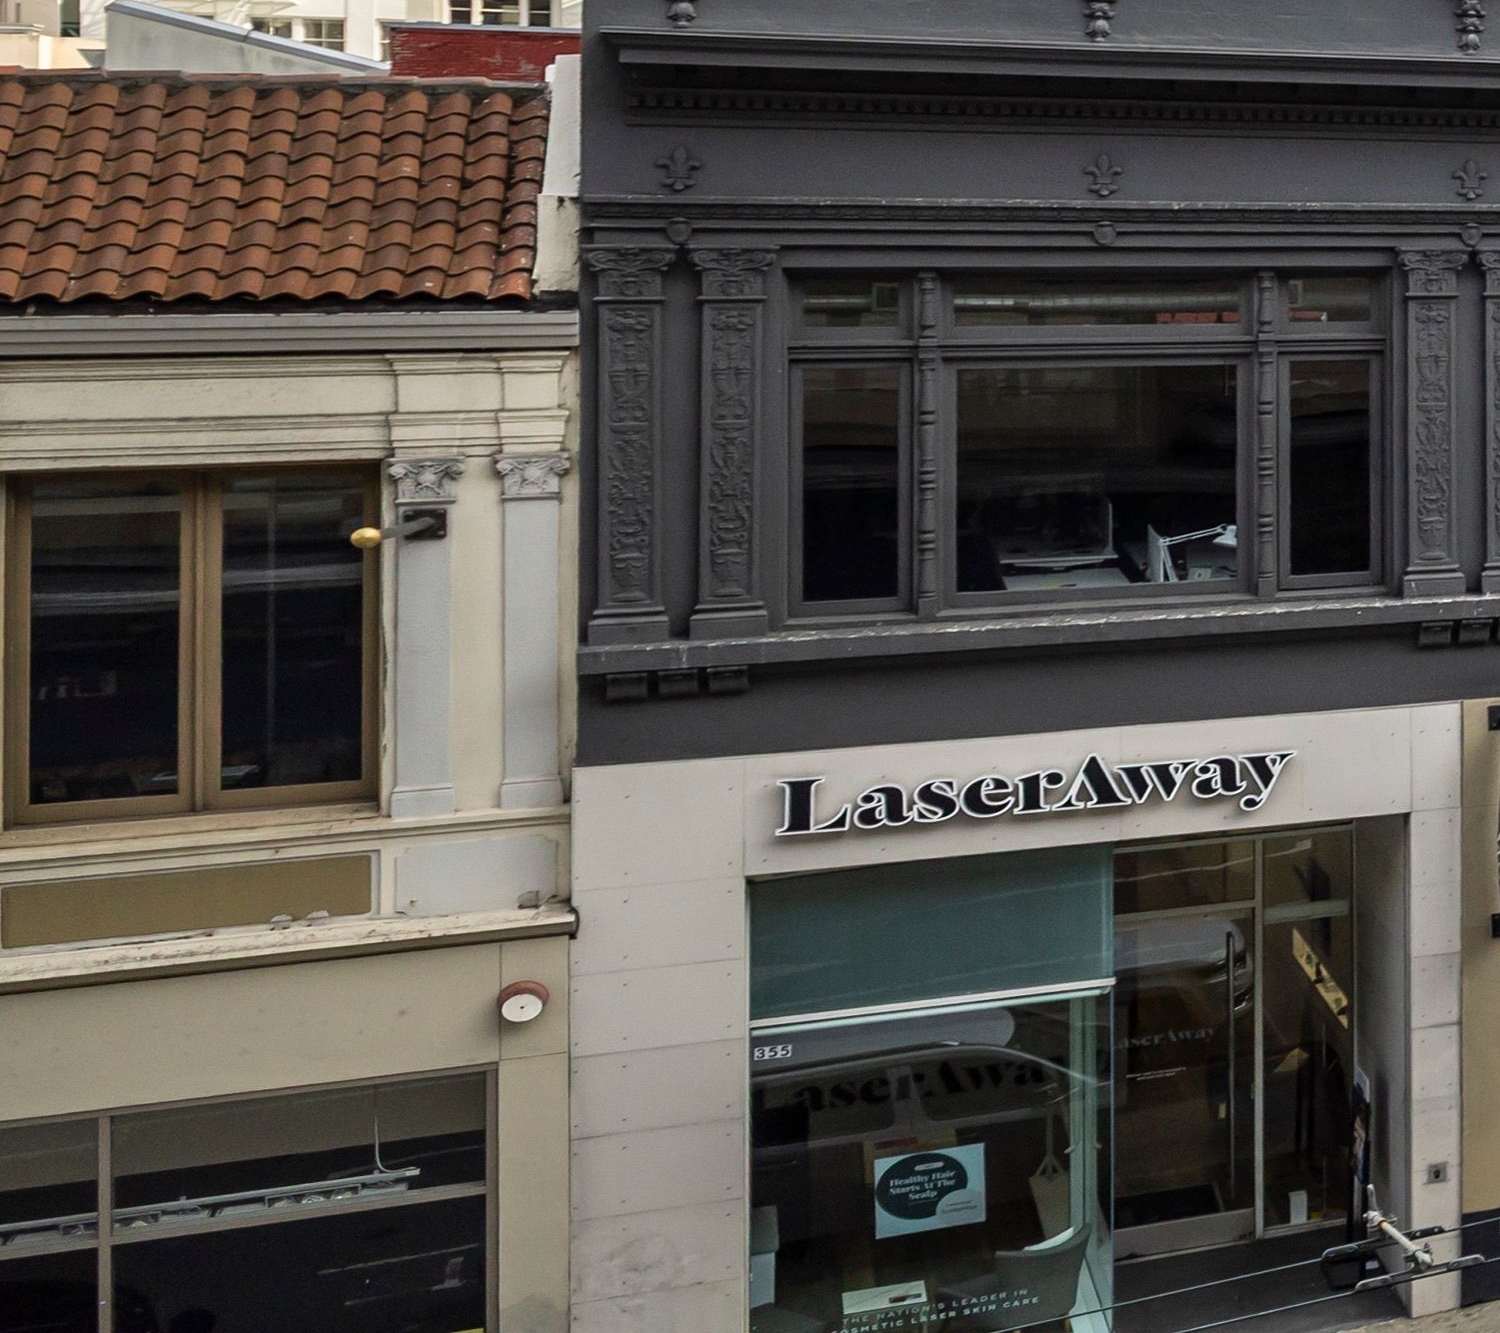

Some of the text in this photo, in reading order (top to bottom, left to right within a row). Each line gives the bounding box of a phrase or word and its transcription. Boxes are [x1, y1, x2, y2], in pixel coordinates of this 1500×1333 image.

[775, 751, 1297, 837] LaserAway
[756, 1044, 791, 1059] 355
[889, 1170, 956, 1188] Healthy Hair
[889, 1185, 920, 1195] Starts
[937, 1179, 956, 1188] The
[908, 1190, 937, 1200] Scalp
[842, 1288, 1029, 1326] THE NATION'S LEADER IN
[910, 1309, 957, 1325] LASER
[962, 1302, 997, 1316] SKIN
[1002, 1296, 1041, 1309] CARE
